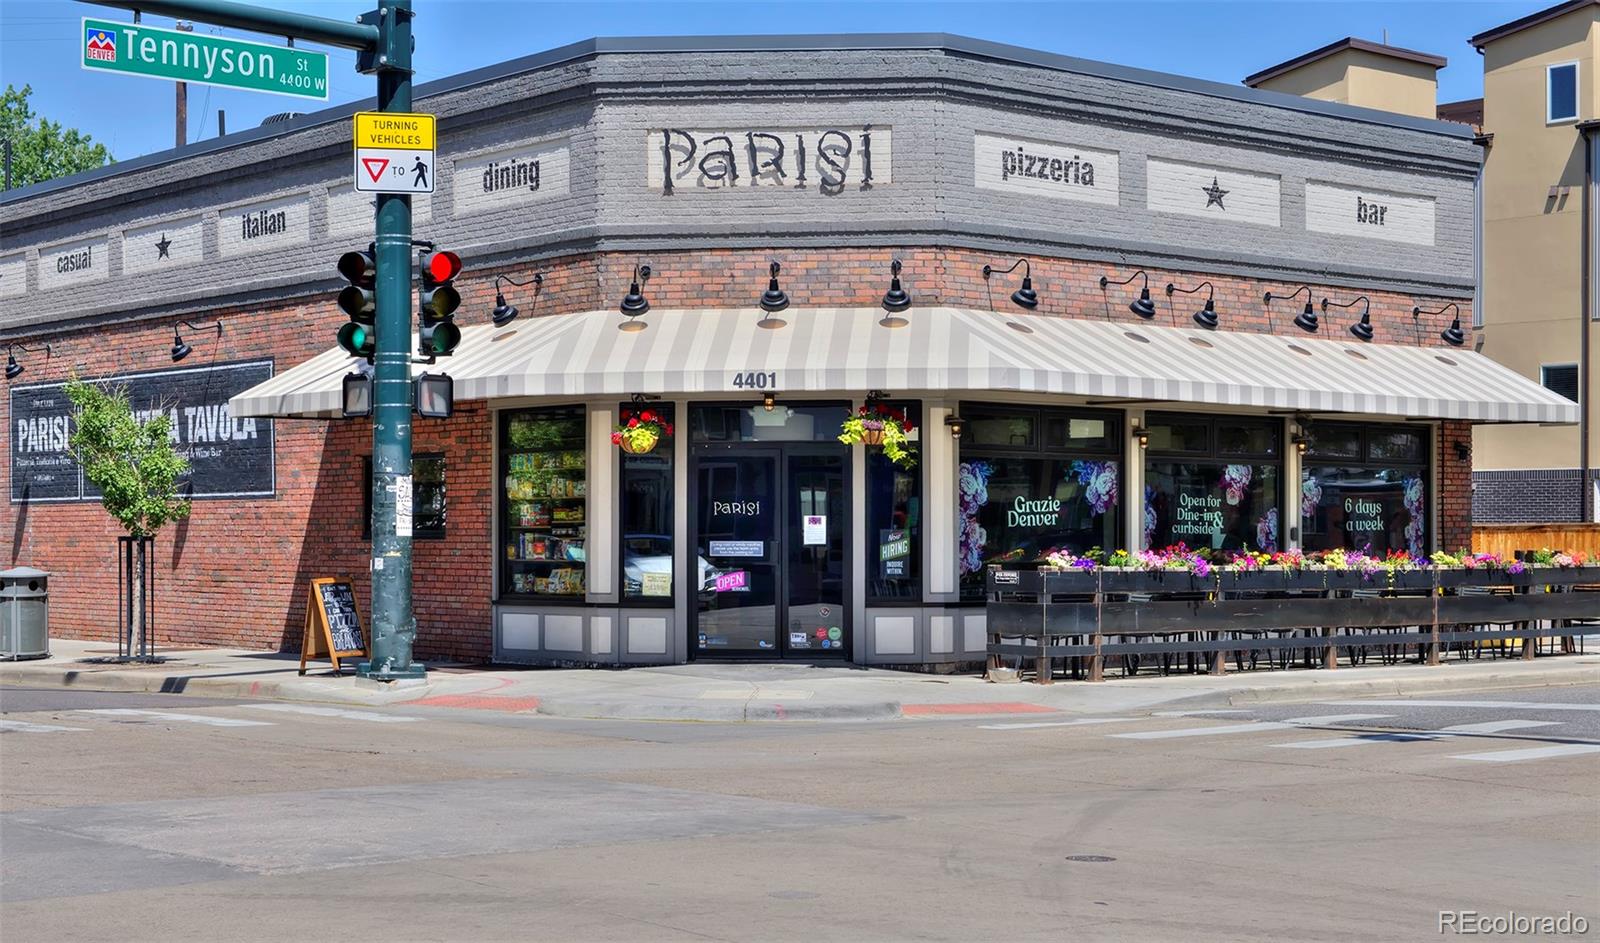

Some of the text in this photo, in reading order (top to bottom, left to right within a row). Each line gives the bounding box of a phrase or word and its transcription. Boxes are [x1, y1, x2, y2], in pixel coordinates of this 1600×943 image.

[87, 48, 116, 62] DENVER
[122, 29, 274, 80] Tennyson
[296, 58, 308, 72] St
[279, 73, 325, 91] 4400 W
[373, 120, 418, 131] TURNING
[370, 134, 421, 145] VEHICLES
[392, 166, 405, 176] TO
[1002, 147, 1094, 187] pizzeria
[483, 159, 540, 193] dining
[1357, 196, 1387, 226] bar
[242, 210, 287, 240] italian
[56, 246, 92, 274] casual
[733, 372, 776, 389] 4401
[18, 416, 69, 453] PARISI
[1014, 496, 1061, 513] Grazie
[1180, 493, 1221, 509] Open for
[1344, 498, 1382, 517] 6 days
[1008, 511, 1058, 527] Denver
[1177, 508, 1224, 529] Dine-in &
[1346, 515, 1384, 531] a week
[1172, 521, 1214, 534] curbside
[887, 532, 902, 542] Now
[882, 540, 908, 559] HIRING
[717, 572, 744, 590] OPEN
